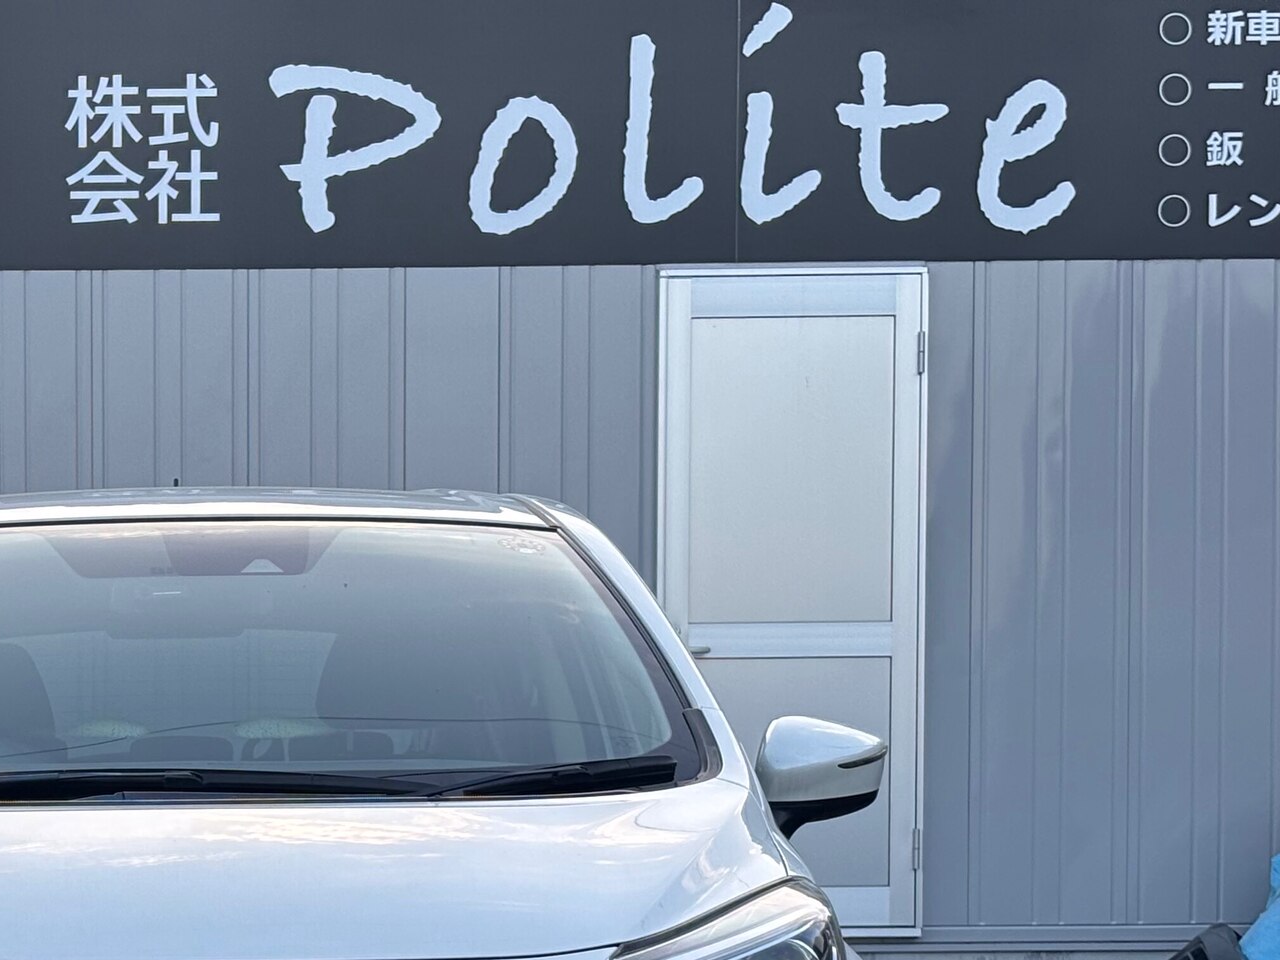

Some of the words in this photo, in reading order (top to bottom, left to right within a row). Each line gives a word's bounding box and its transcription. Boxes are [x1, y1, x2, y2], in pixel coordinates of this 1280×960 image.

[1207, 10, 1280, 46] 新車
[65, 74, 219, 150] 株式
[269, 3, 1075, 235] Polite
[1207, 132, 1243, 167] 鈑
[66, 151, 220, 225] 会社
